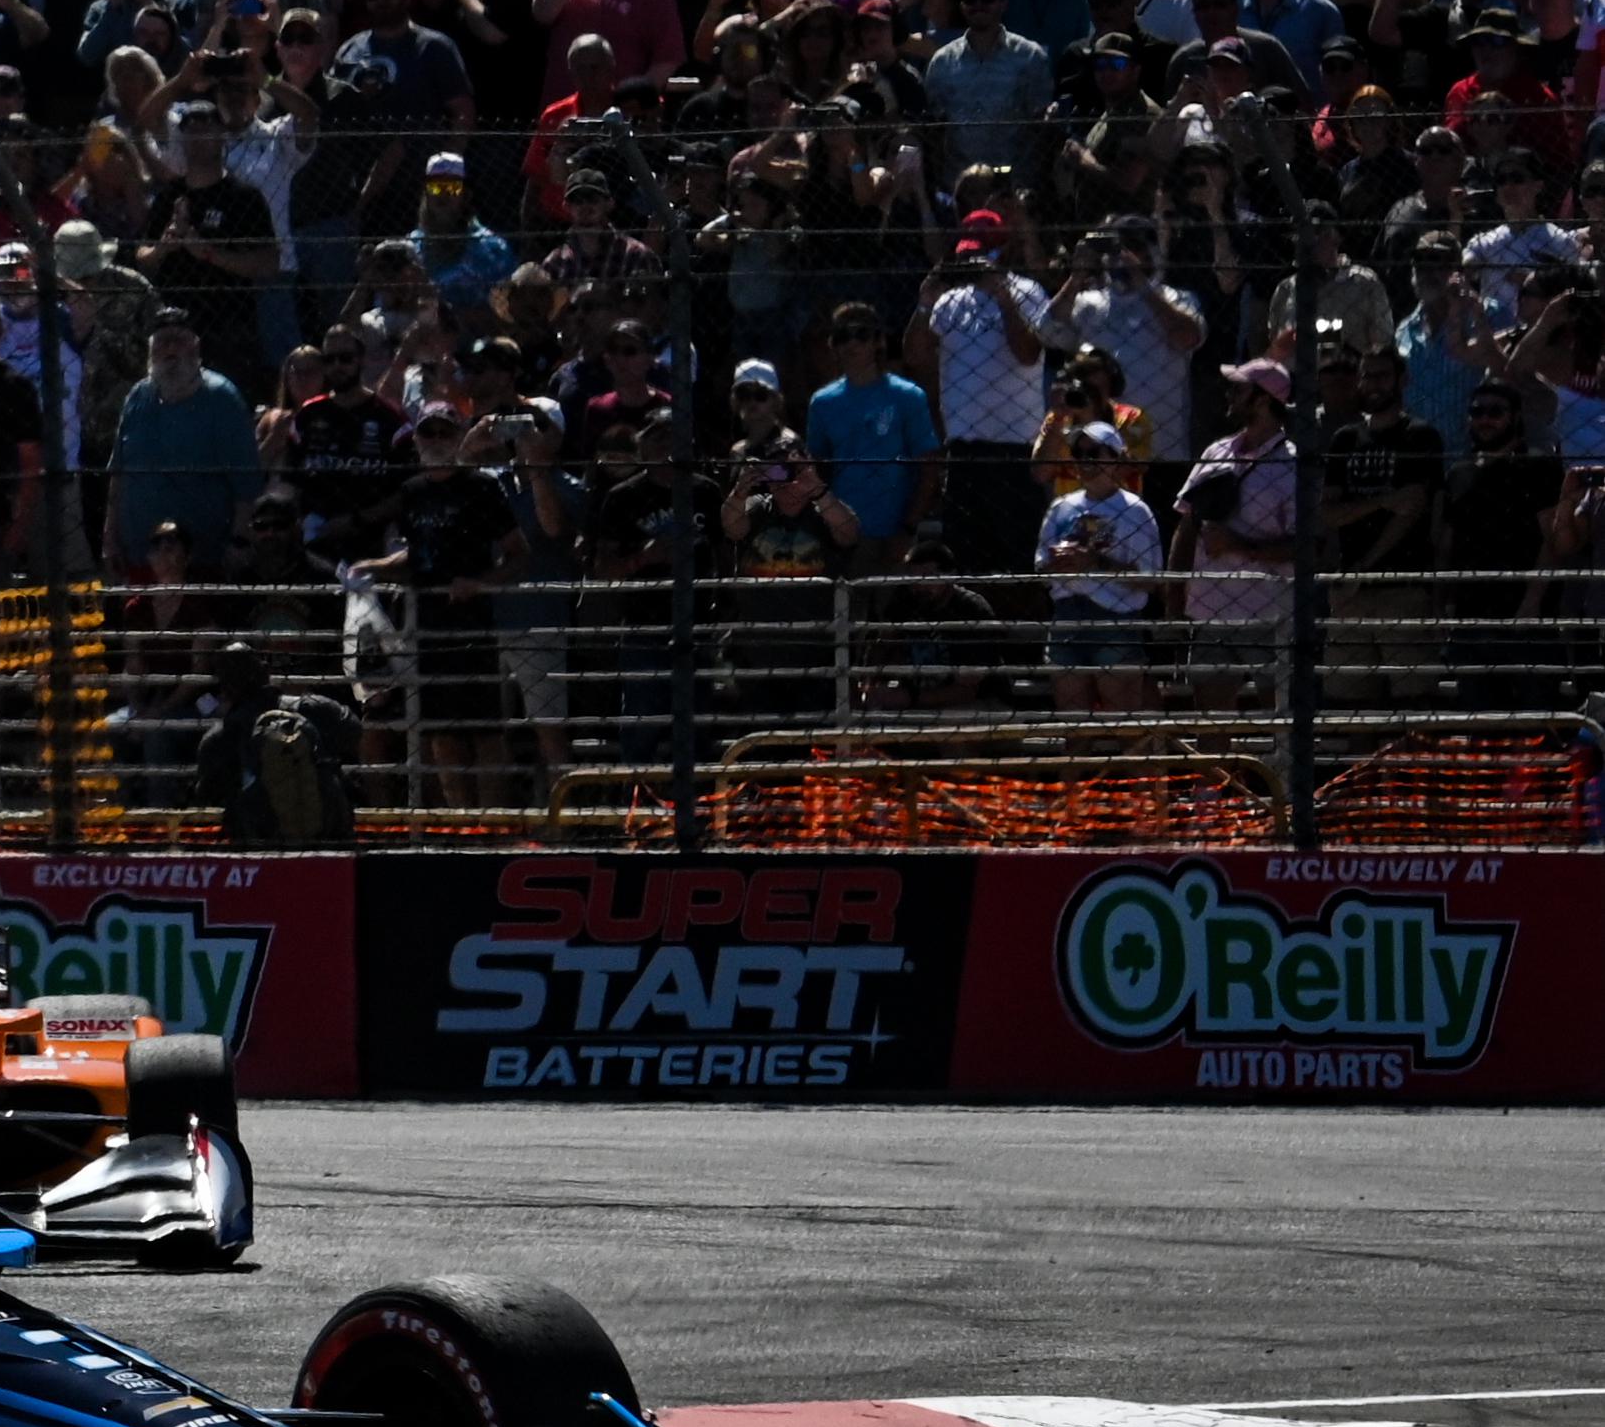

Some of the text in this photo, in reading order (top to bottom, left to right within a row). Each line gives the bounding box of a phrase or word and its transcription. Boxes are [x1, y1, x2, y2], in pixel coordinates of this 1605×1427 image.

[34, 864, 259, 887] EXCLUSIVELY AT
[1265, 857, 1503, 884] EXCLUSIVELY AT
[490, 860, 903, 943] SUPER
[437, 933, 904, 1032] START
[1075, 885, 1490, 1041] O'Reilly
[46, 1019, 127, 1032] SONAX
[483, 1044, 855, 1088] BATTERIES
[1196, 1049, 1405, 1091] AUTO PARTS
